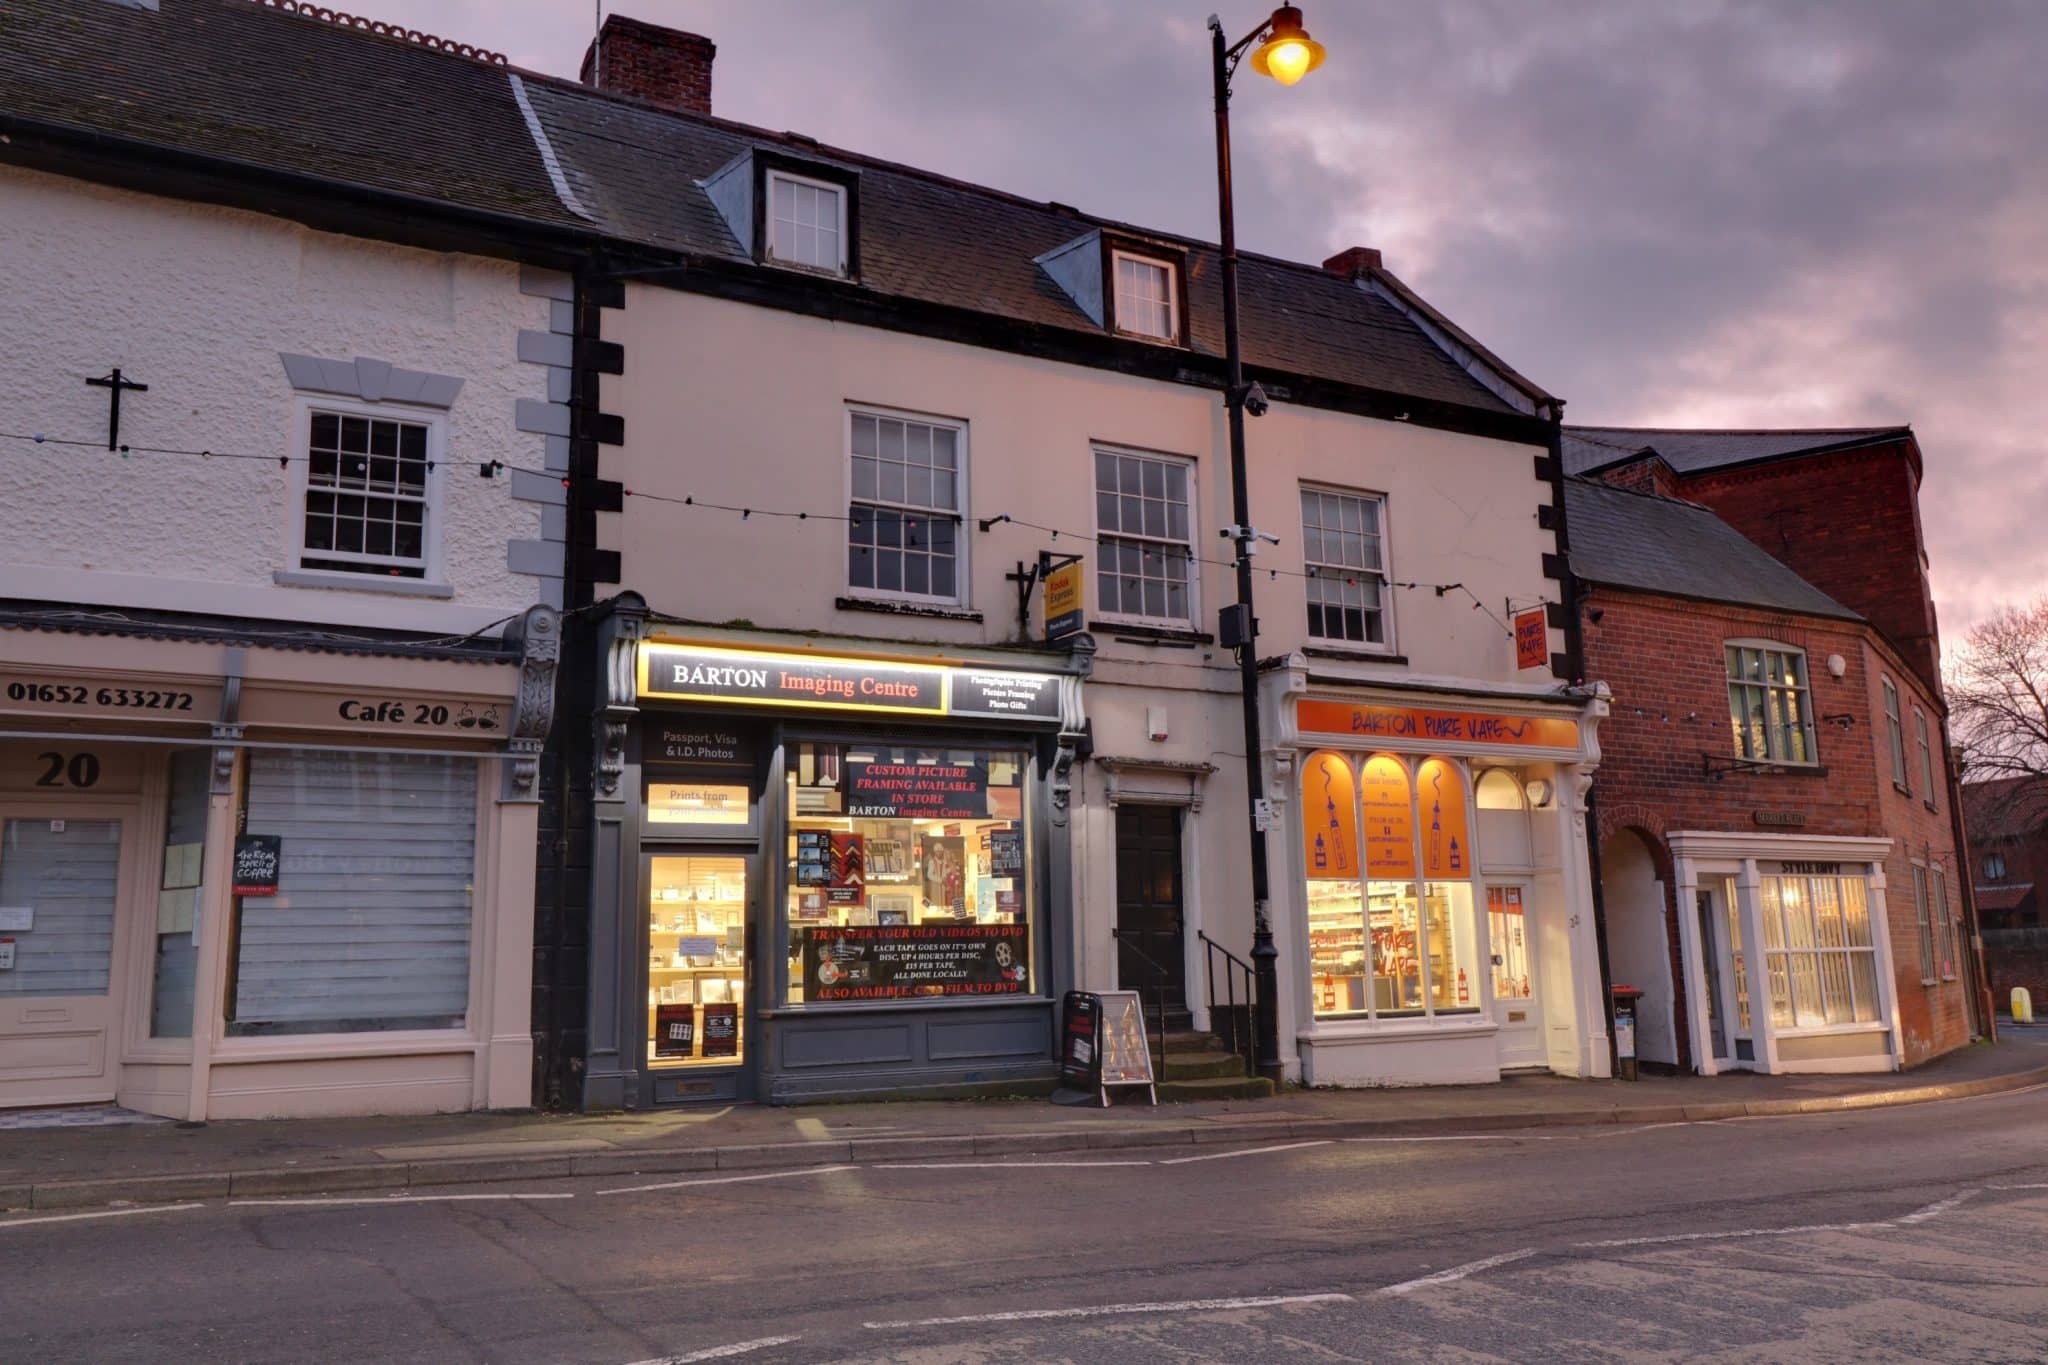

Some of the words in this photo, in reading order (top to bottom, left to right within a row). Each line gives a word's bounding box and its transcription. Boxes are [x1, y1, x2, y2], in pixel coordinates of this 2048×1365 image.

[1049, 587, 1074, 604] Express
[673, 665, 768, 688] BARTON
[779, 671, 855, 696] Imaging
[860, 677, 919, 698] Centre
[7, 683, 88, 704] 01652
[96, 688, 193, 711] 633272
[982, 688, 1006, 697] Picture
[1008, 690, 1035, 700] Framing
[989, 700, 1008, 708] Photo
[1010, 701, 1027, 710] Gifts
[339, 700, 405, 723] Café
[414, 704, 449, 725] 20
[1352, 711, 1416, 735] BARTON
[1424, 716, 1463, 737] PURE
[1467, 719, 1503, 739] VAPE
[663, 731, 712, 744] Passport,
[715, 734, 737, 745] Visa
[666, 746, 675, 757] &
[678, 746, 696, 757] I.D.
[698, 747, 734, 759] Photos
[35, 752, 101, 788] 20
[865, 765, 915, 776] CUSTOM
[918, 767, 968, 778] PICTURE
[856, 779, 912, 790] FRAMING
[915, 780, 977, 791] AVAILABLE
[670, 790, 700, 800] Prints
[703, 791, 728, 801] from
[891, 794, 904, 803] IN
[907, 794, 945, 804] STORE
[849, 806, 897, 816] BARTON
[898, 807, 938, 818] Imaging
[940, 808, 973, 817] Centre
[1781, 861, 1814, 874] STYLE
[1814, 862, 1840, 875] ENVY
[811, 929, 873, 941] TRANSFER
[876, 929, 910, 940] YOUR
[913, 928, 937, 939] OLD
[940, 928, 981, 938] VIDEOS
[984, 927, 1001, 937] TO
[1001, 927, 1025, 937] DVD
[1371, 930, 1414, 951] PURE
[873, 944, 896, 952] EACH
[896, 943, 918, 951] TAPE
[919, 943, 938, 951] GOES
[939, 943, 951, 951] ON
[951, 942, 965, 950] IT'S
[967, 942, 986, 950] OWN
[879, 953, 899, 961] DISC,
[901, 953, 912, 961] UP
[918, 952, 944, 960] HOURS
[945, 952, 960, 960] PER
[1377, 955, 1415, 976] VAPE
[893, 971, 909, 979] ALL
[910, 971, 931, 979] DONE
[933, 970, 968, 978] LOCALLY
[817, 988, 849, 999] ALSO
[945, 983, 975, 993] FILM
[977, 983, 993, 992] TO
[995, 982, 1019, 992] DVD
